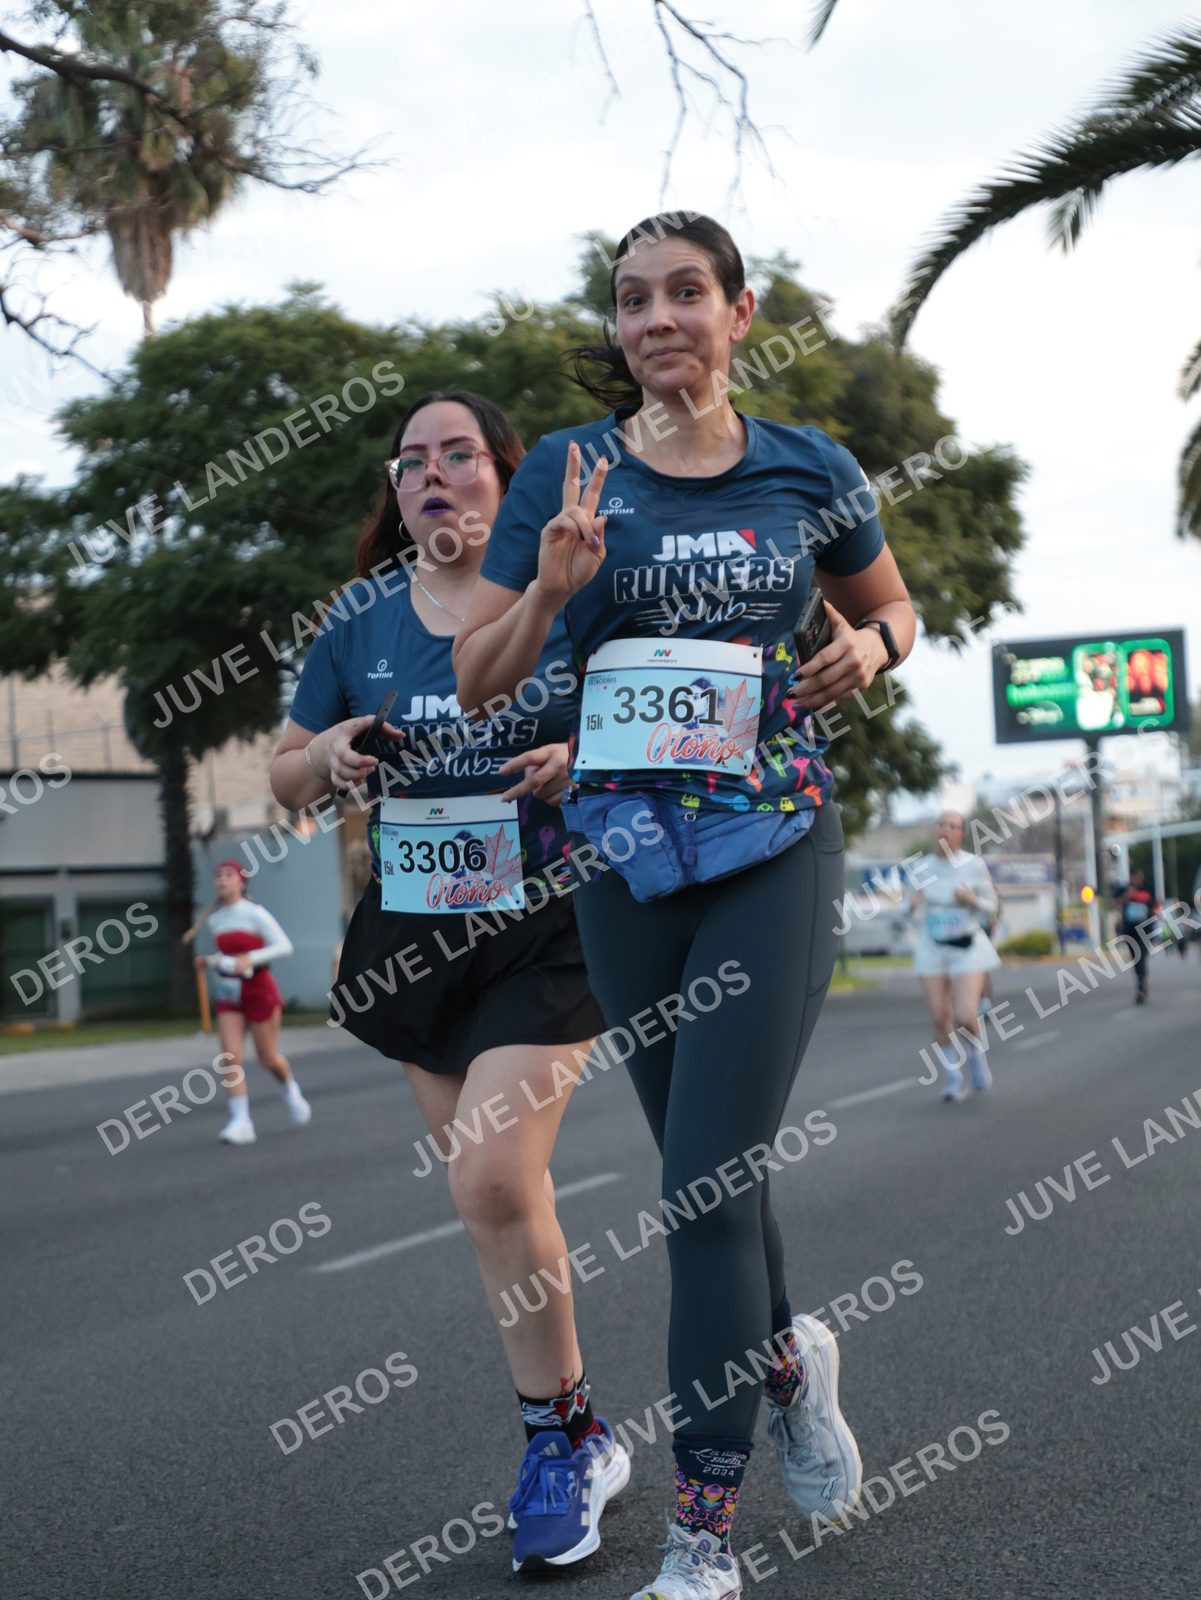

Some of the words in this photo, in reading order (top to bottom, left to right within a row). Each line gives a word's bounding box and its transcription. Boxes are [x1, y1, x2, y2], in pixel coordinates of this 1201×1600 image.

[652, 528, 758, 562] JMA
[614, 556, 795, 604] RUNNERS
[401, 694, 467, 722] JM
[586, 713, 604, 732] 15k
[612, 685, 724, 726] 3361
[398, 838, 488, 874] 3306
